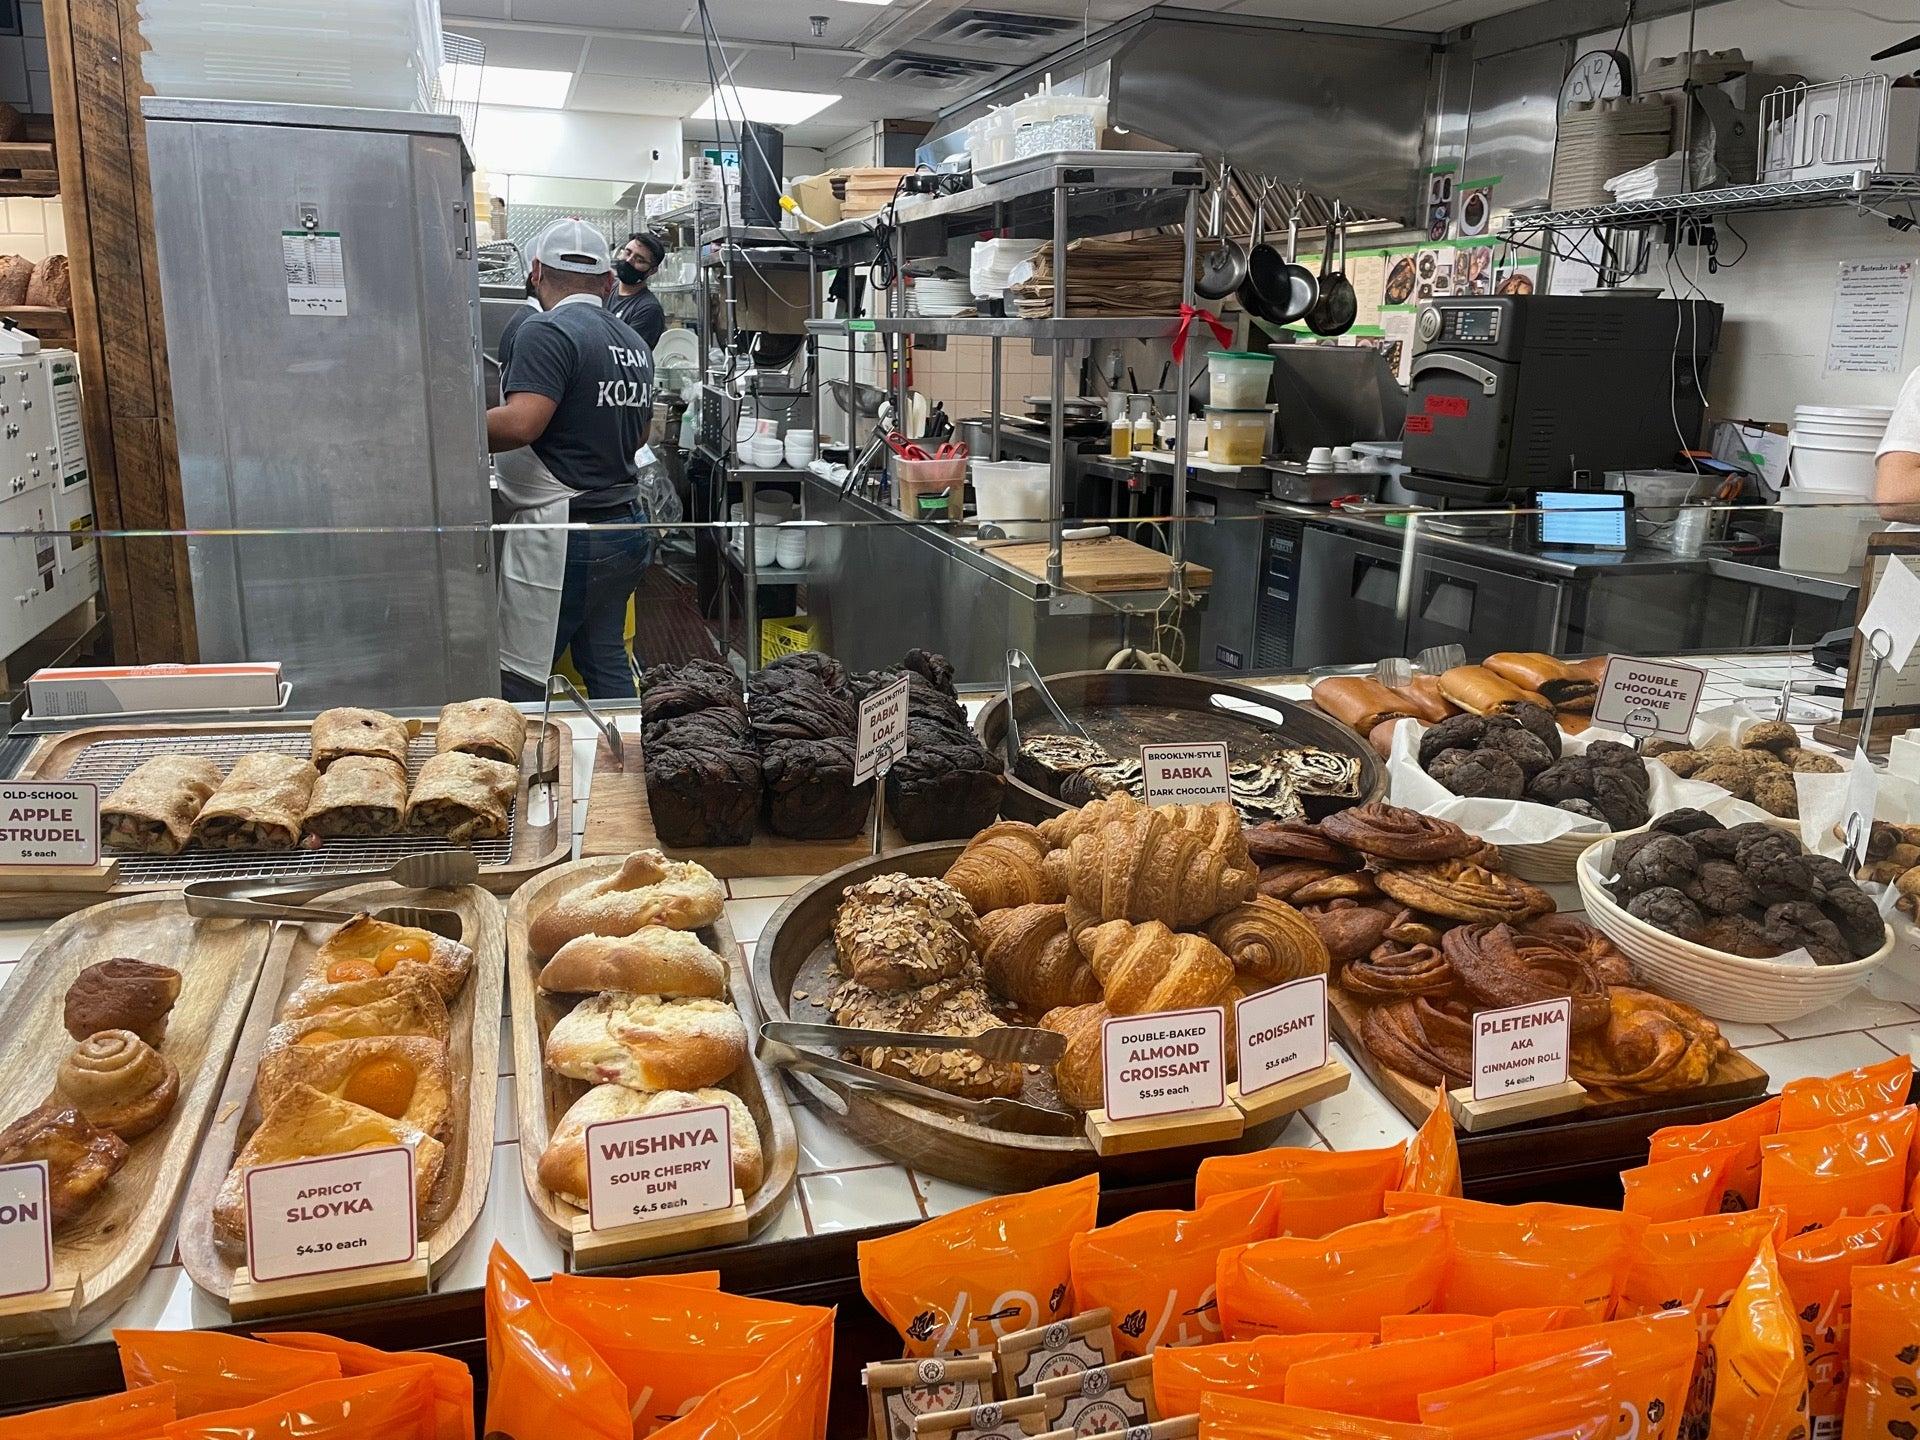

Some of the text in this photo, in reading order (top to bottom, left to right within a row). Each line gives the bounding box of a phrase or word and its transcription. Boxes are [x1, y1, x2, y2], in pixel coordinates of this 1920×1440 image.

[1593, 58, 1603, 74] 12
[608, 345, 649, 369] TEAM
[1628, 672, 1679, 688] DOUBLE
[863, 685, 906, 715] BROOKLYN-STYLE
[1614, 681, 1688, 701] CHOCOLATE
[1624, 695, 1671, 710] COOKIE
[869, 702, 899, 728] BABKA
[1633, 714, 1652, 723] $1.75
[872, 721, 896, 744] LOAF
[859, 749, 875, 763] DARK
[1148, 751, 1222, 761] BROOKLYN-STYLE
[1161, 766, 1213, 780] BABKA
[2, 791, 79, 800] OLD-SCHOOL
[1150, 786, 1227, 797] DARK CHOCOLATE
[8, 808, 73, 822] APPLE
[0, 828, 86, 842] STRUDEL
[21, 849, 57, 858] $5 each
[1248, 1014, 1315, 1047] CROISSANT
[1480, 1008, 1565, 1037] PLETENKA
[1121, 1027, 1206, 1045] DOUBLE-BAKED
[1510, 1038, 1534, 1051] AKA
[1128, 1042, 1200, 1063] ALMOND
[1265, 1052, 1298, 1071] $3.5 each
[1119, 1060, 1210, 1083] CROISSANT
[1481, 1051, 1561, 1074] CINNAMON ROLL
[1504, 1074, 1535, 1088] $4 each
[1139, 1085, 1190, 1100] $5.95 each
[600, 1128, 719, 1161] WISHNYA
[610, 1159, 711, 1186] SOUR CHERRY
[296, 1181, 362, 1200] APRICOT
[646, 1180, 678, 1195] BUN
[286, 1197, 374, 1223] SLOYKA
[633, 1197, 688, 1215] $4.5 each
[295, 1237, 368, 1256] $4.30 each
